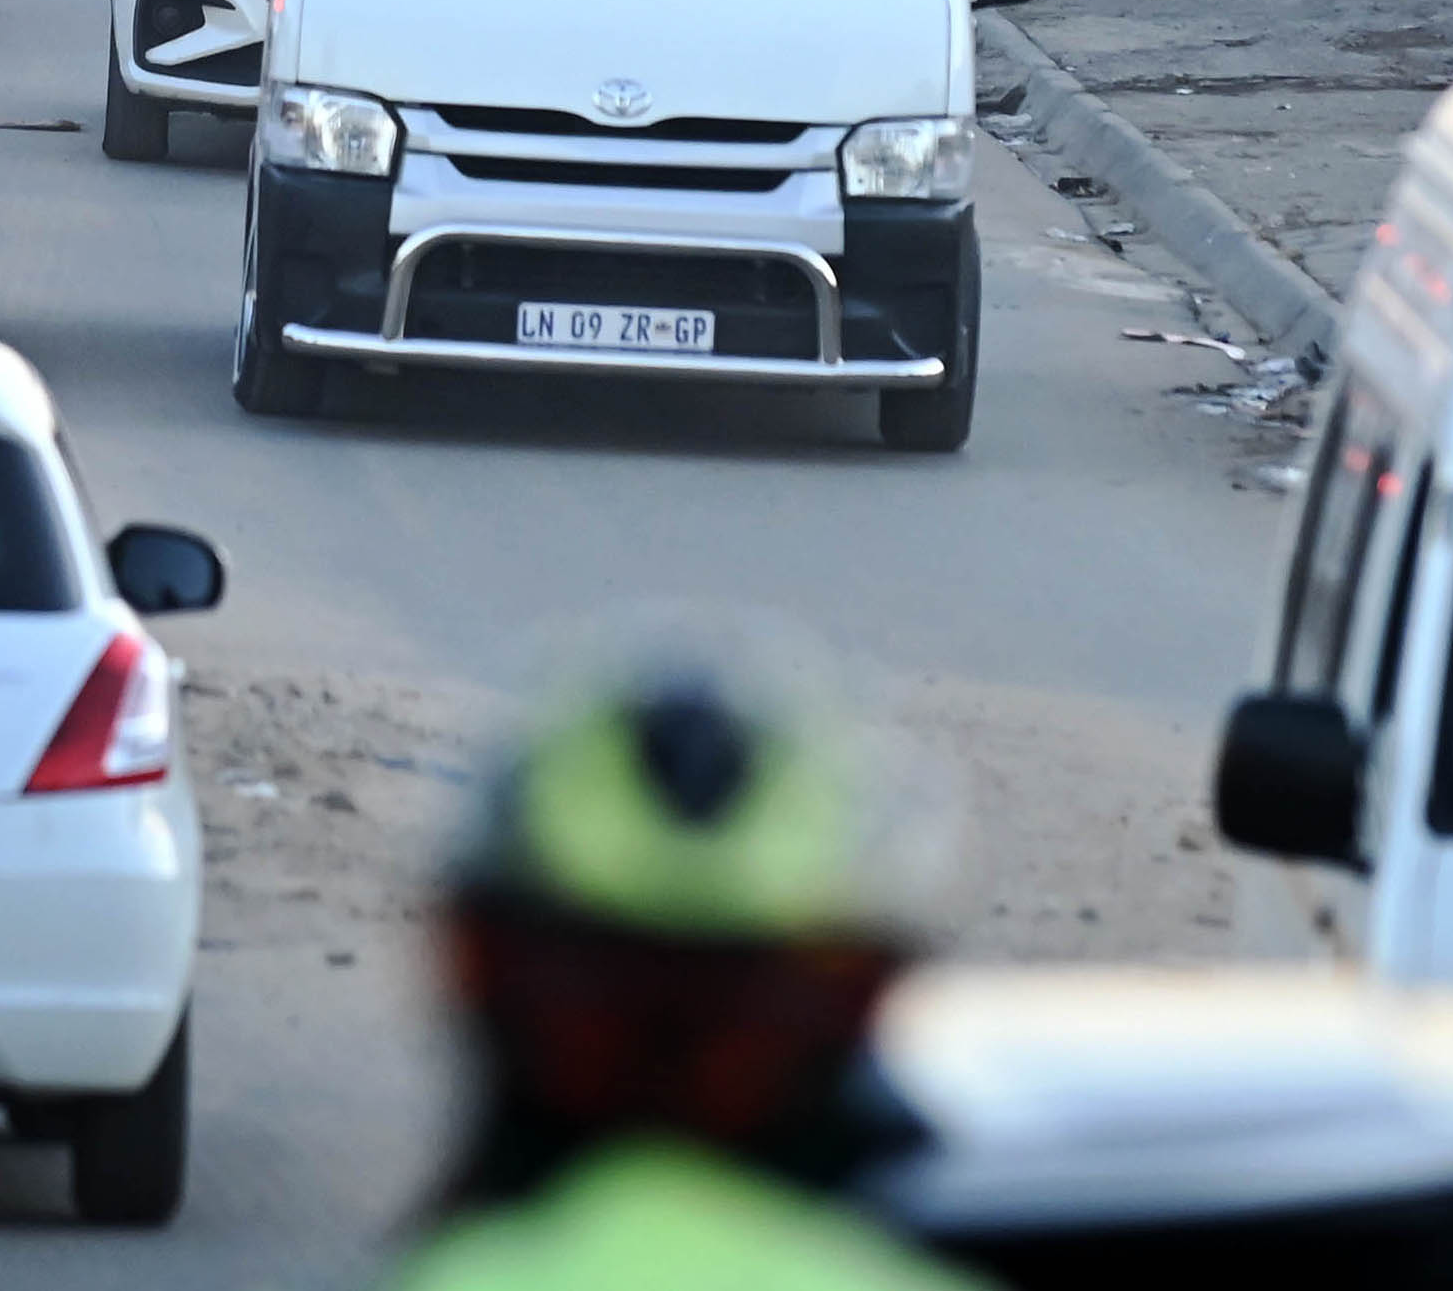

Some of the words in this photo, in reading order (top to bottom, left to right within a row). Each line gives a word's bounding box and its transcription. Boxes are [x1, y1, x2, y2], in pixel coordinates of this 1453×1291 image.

[522, 309, 555, 338] LN
[571, 311, 602, 339] 09
[620, 313, 651, 342] ZR
[675, 316, 707, 344] GP
